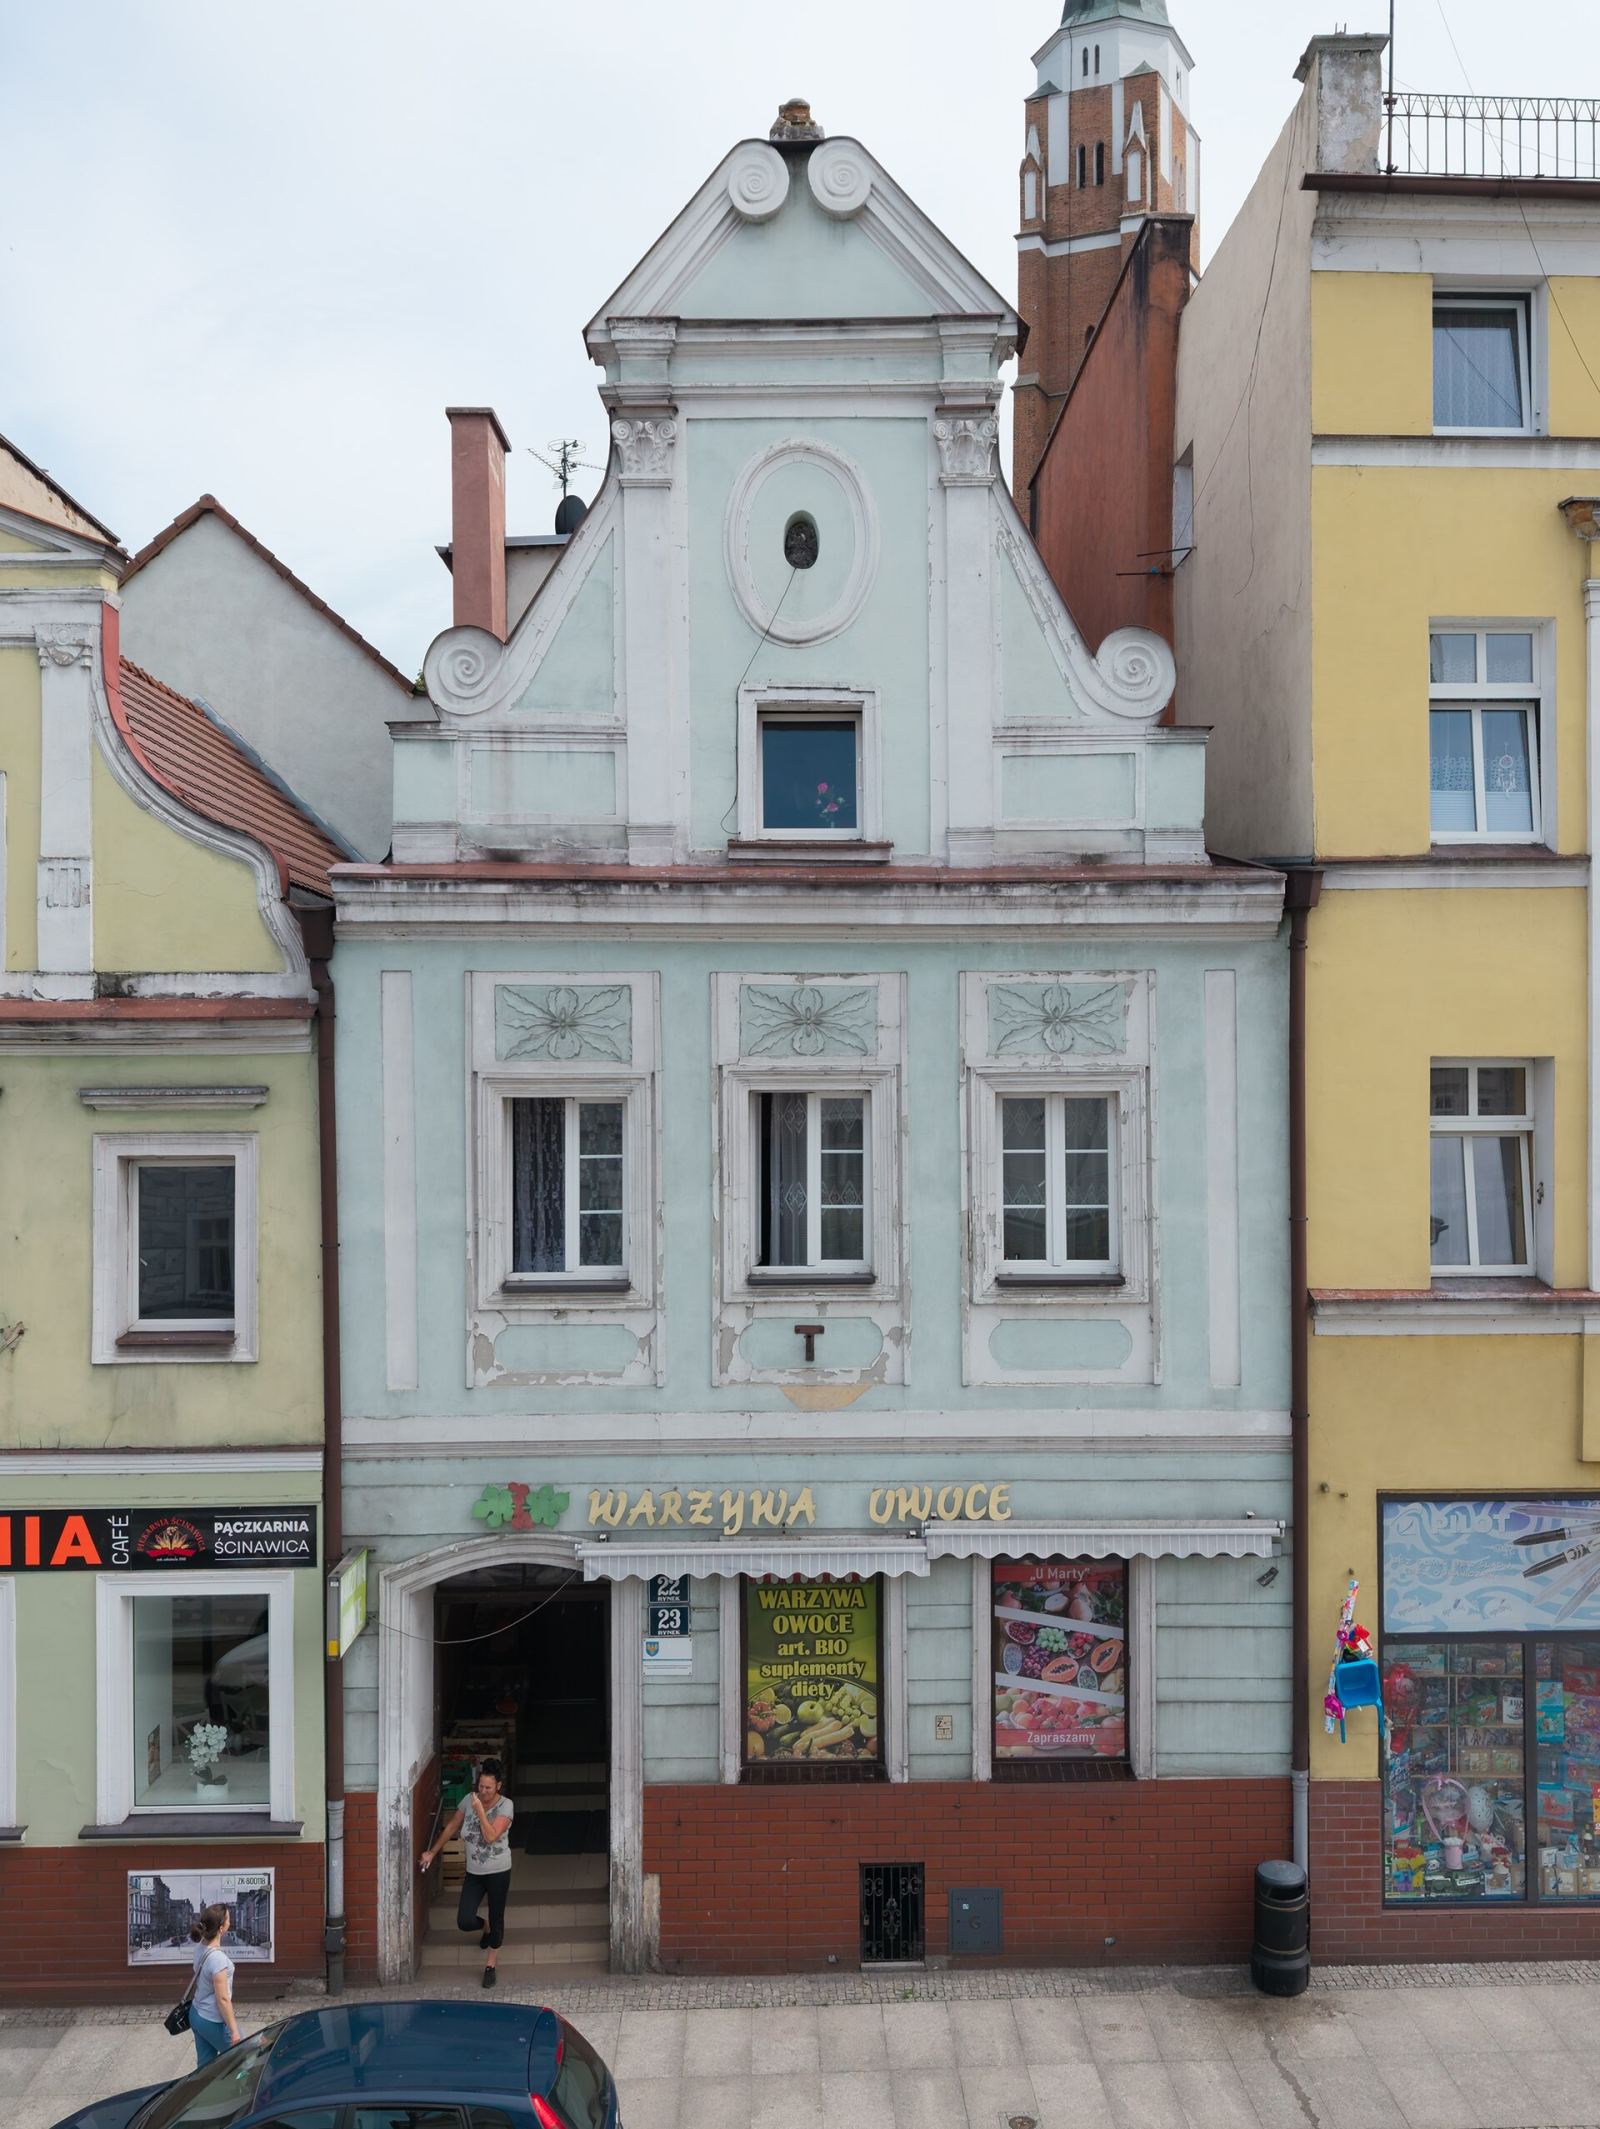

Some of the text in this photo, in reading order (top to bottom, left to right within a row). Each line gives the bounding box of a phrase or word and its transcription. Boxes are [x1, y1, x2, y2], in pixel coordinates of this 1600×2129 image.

[587, 1487, 816, 1535] WARZYWA
[213, 1520, 309, 1535] PĄCZKARNIA
[0, 1515, 102, 1566] IA
[107, 1514, 129, 1565] CAFÉ
[214, 1537, 309, 1555] ŚCINAWICA
[657, 1577, 680, 1596] 22
[758, 1588, 865, 1609] WARZYWA
[657, 1609, 681, 1629] 23
[772, 1614, 853, 1635] OWOCE
[777, 1639, 848, 1656] art. BIO
[761, 1660, 864, 1680] suplementy
[791, 1680, 834, 1700] diety
[1027, 1732, 1096, 1744] Zapraszamy
